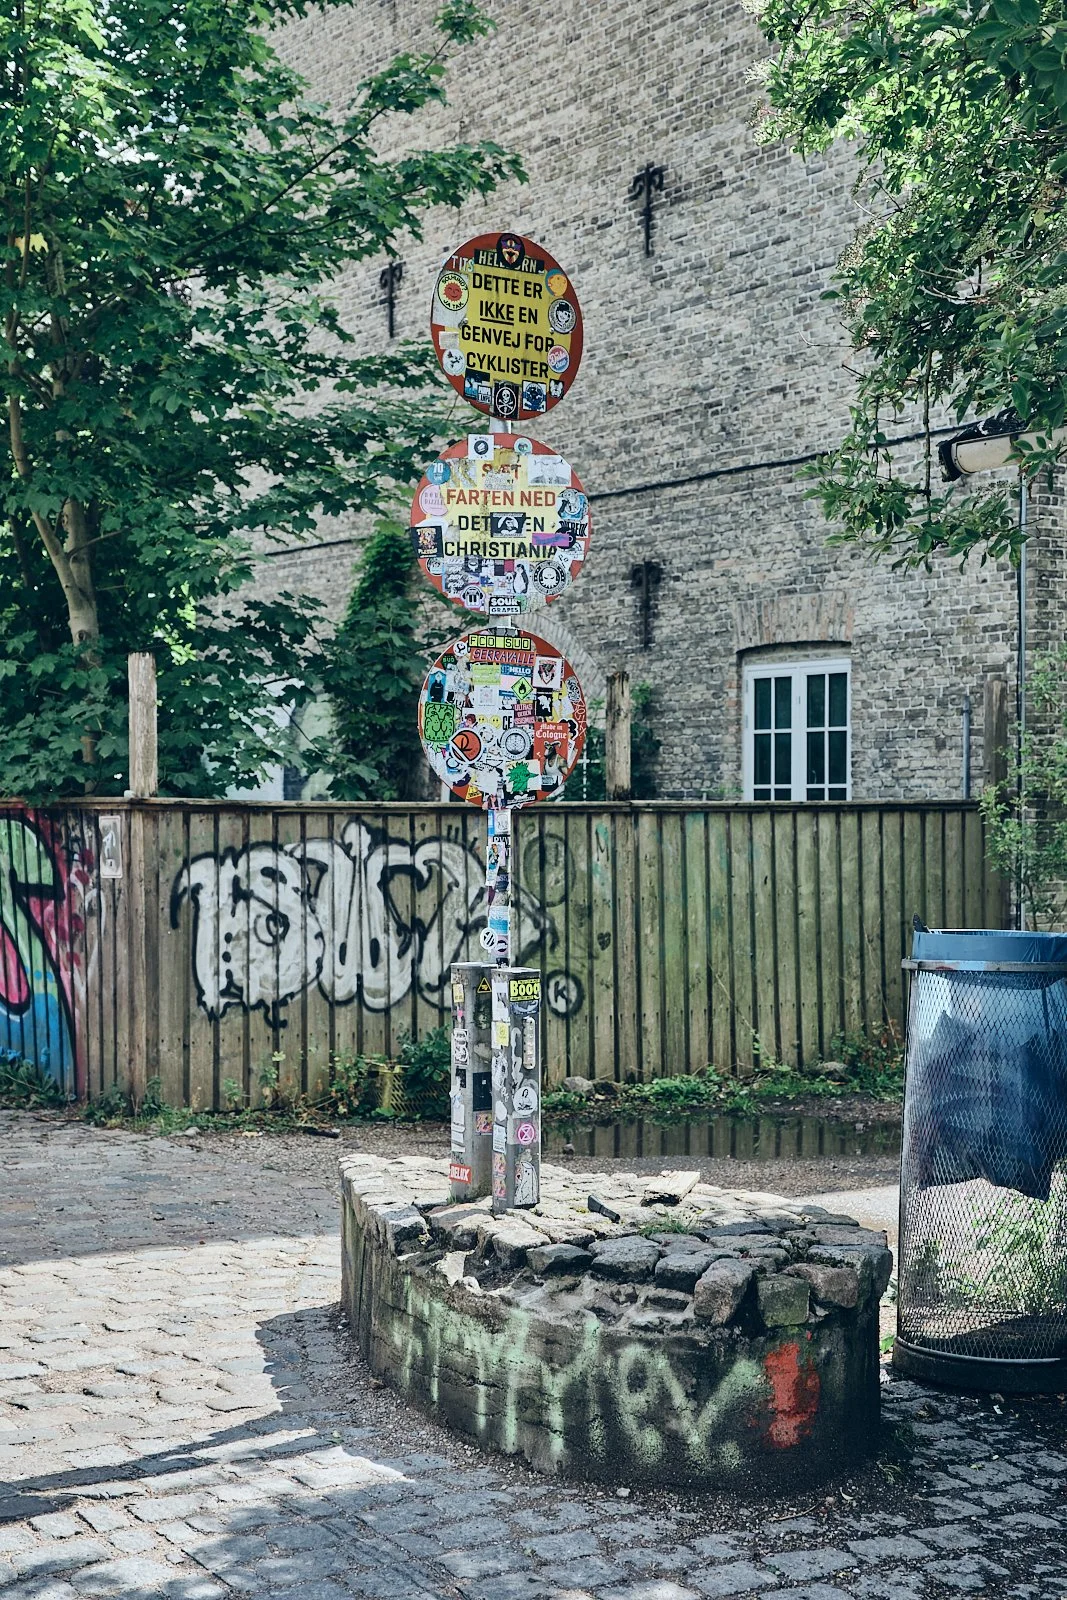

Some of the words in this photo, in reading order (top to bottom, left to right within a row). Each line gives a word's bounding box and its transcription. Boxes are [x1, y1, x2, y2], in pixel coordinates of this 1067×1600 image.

[472, 272, 519, 296] DETTE
[523, 281, 543, 299] ER
[479, 300, 515, 321] IKKE
[518, 307, 538, 324] EN
[461, 325, 521, 349] GENVEJ
[525, 332, 555, 353] FOR
[466, 352, 549, 379] CYKLISTER
[446, 489, 514, 506] FARTEN
[520, 490, 556, 507] NED
[444, 541, 557, 558] CHRISTIANIA
[535, 730, 567, 740] Cologne
